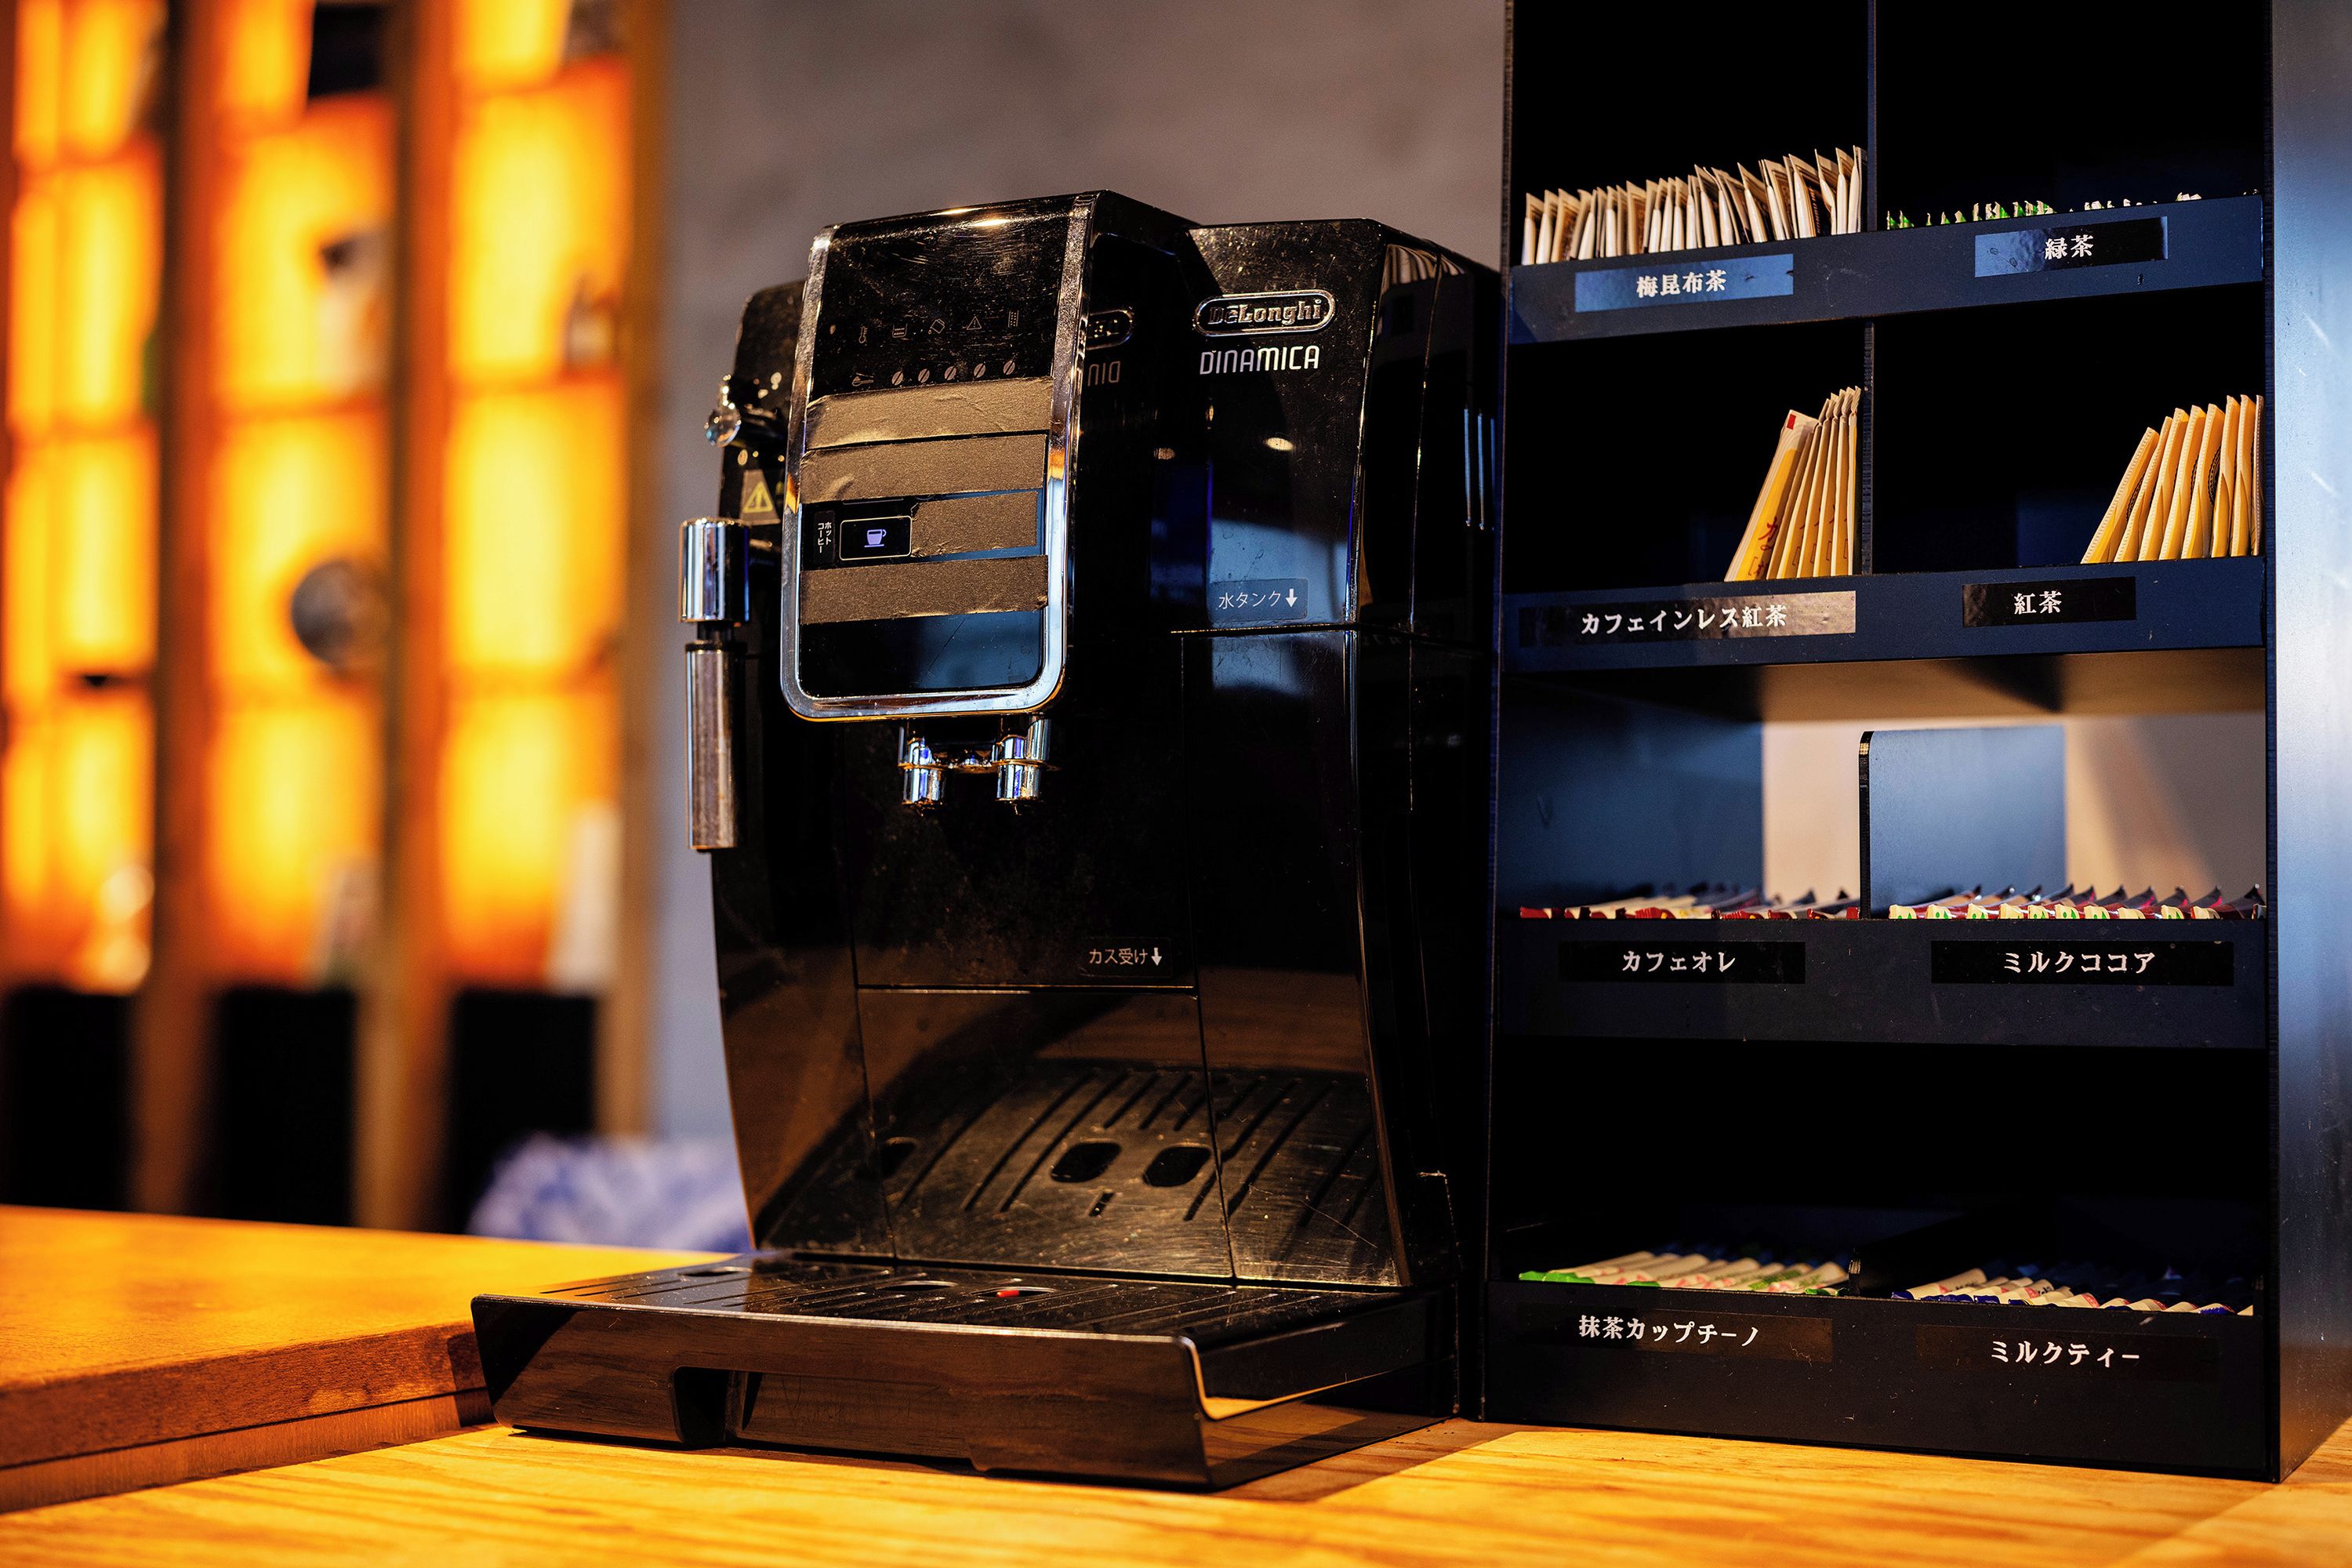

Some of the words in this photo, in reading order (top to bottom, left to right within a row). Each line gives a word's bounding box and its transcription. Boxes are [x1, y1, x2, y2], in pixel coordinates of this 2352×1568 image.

[2044, 234, 2094, 260] 緑茶
[1635, 269, 1726, 298] 梅昆布茶
[1200, 345, 1320, 375] DINAMICA
[1218, 590, 1281, 610] 水タンク
[2013, 590, 2062, 615] 紅茶
[1581, 604, 1788, 635] カフェインレス紅茶
[1089, 948, 1149, 965] カス受け
[1622, 950, 1736, 973] カフェオレ
[2003, 951, 2156, 975] ミルクココア
[1579, 1314, 1759, 1347] 抹茶カップチーノ
[1991, 1340, 2140, 1368] ミルクティー
